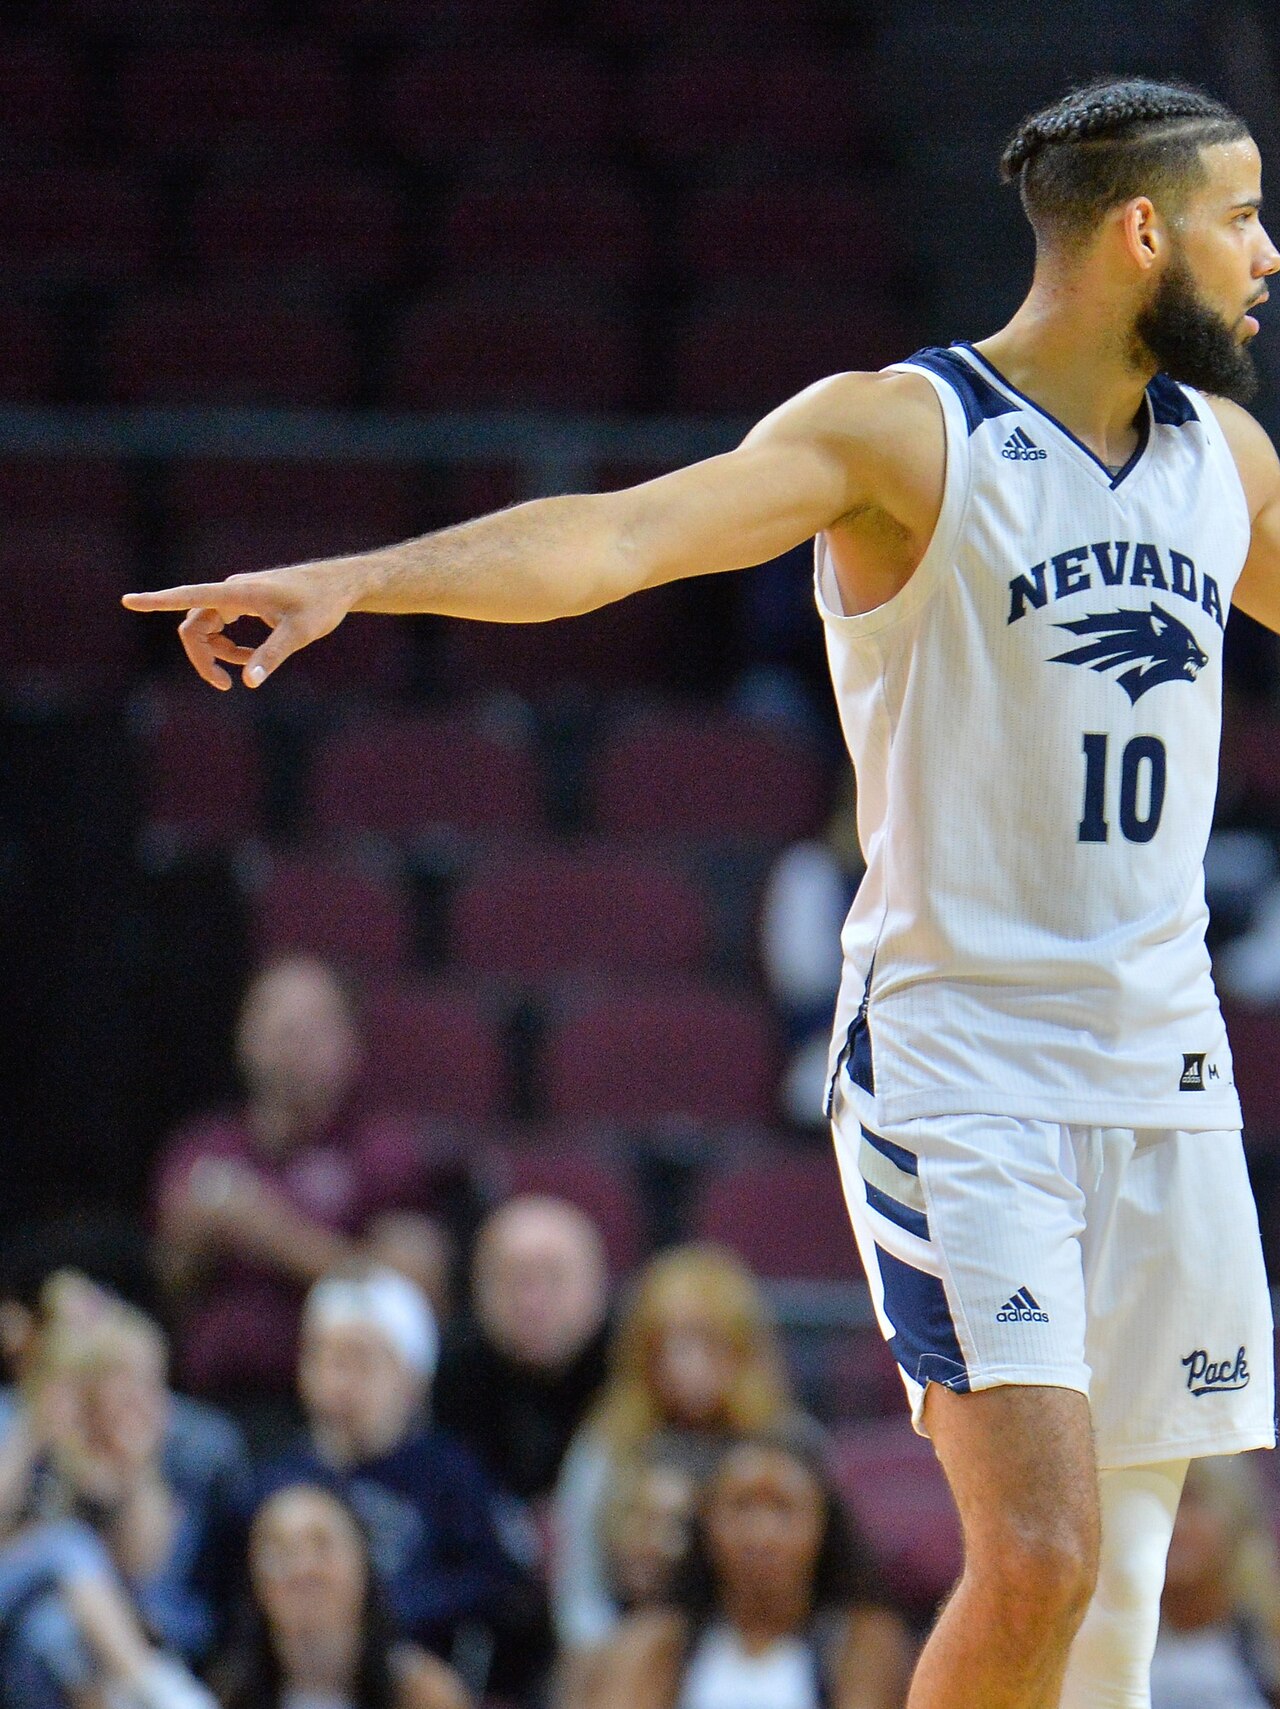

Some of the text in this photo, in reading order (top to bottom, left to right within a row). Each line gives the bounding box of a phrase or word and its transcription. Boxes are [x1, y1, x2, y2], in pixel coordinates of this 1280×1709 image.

[1001, 447, 1048, 461] adidas
[1007, 541, 1225, 632] NEVADA
[1077, 731, 1168, 844] 10
[995, 1307, 1050, 1323] adidas
[1182, 1346, 1250, 1397] Pack
